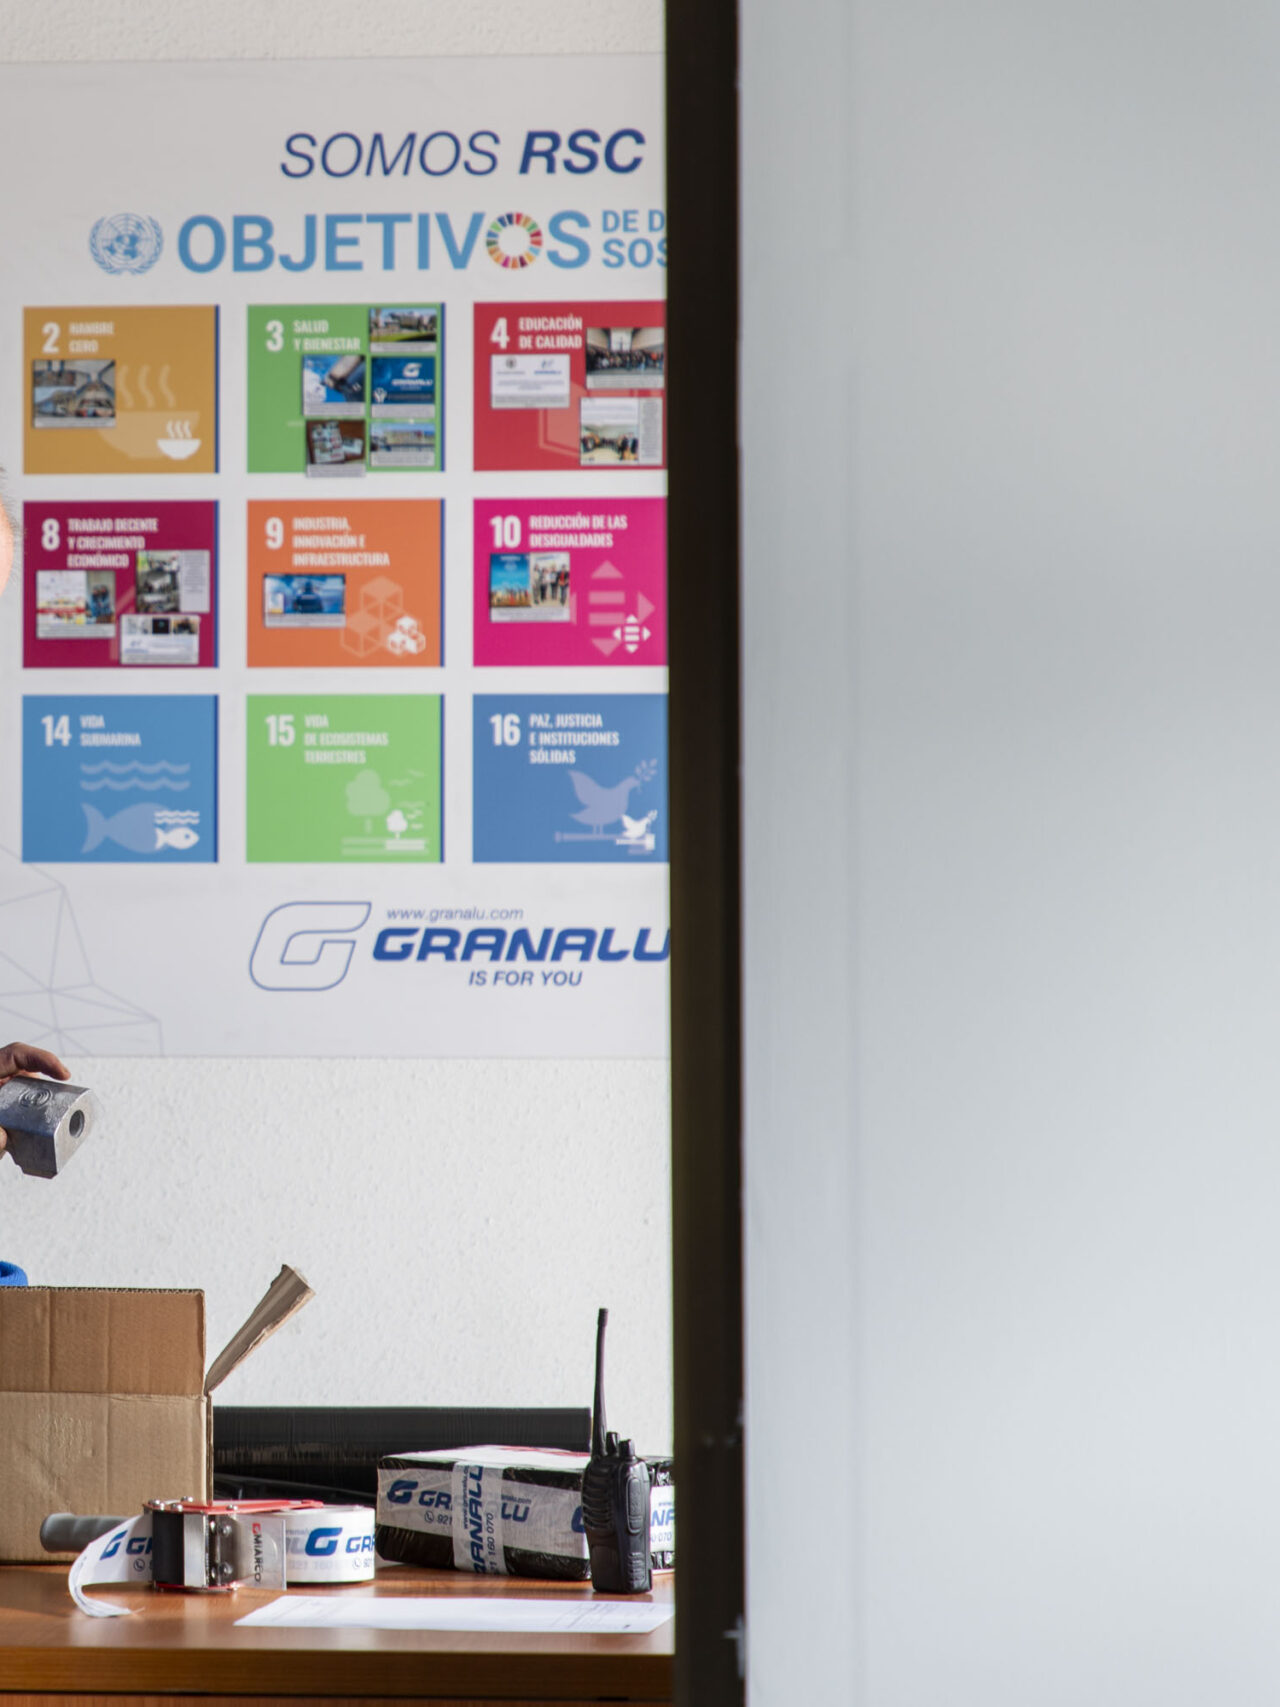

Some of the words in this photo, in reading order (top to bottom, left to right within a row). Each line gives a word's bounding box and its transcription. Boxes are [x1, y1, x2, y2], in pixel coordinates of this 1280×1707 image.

[280, 131, 501, 178] SOMOS
[518, 128, 646, 176] RSC
[601, 209, 640, 233] DE
[177, 210, 592, 273] OBJETIVOS
[293, 319, 329, 333] SALUD
[518, 314, 583, 331] EDUCACIÓN
[42, 321, 61, 354] 2
[265, 319, 284, 352] 3
[490, 317, 511, 350] 4
[518, 335, 533, 349] DE
[535, 335, 583, 349] CALIDAD
[293, 337, 301, 351] Y
[303, 337, 361, 351] BIENESTAR
[529, 512, 590, 529] REDUCCIÓN
[592, 515, 605, 529] DE
[607, 515, 628, 529] LAS
[41, 517, 61, 551] 8
[265, 516, 284, 550] 9
[490, 515, 521, 548] 10
[529, 532, 614, 548] DESIGUALDADES
[67, 535, 76, 550] Y
[358, 534, 366, 549] E
[292, 552, 391, 566] INFRAESTRUCTURA
[80, 715, 106, 728] VIDA
[304, 714, 330, 728] VIDA
[529, 713, 553, 728] PAZ,
[555, 713, 603, 728] JUSTICIA
[41, 714, 72, 747] 14
[265, 714, 295, 747] 15
[490, 713, 521, 746] 16
[304, 732, 318, 746] DE
[319, 732, 389, 746] ECOSISTEMAS
[529, 732, 537, 746] E
[538, 732, 620, 746] INSTITUCIONES
[529, 747, 576, 764] SÓLIDAS
[386, 905, 524, 923] www.granalu.com
[372, 927, 670, 962] GRANALU
[469, 970, 488, 987] IS
[493, 970, 535, 987] FOR
[541, 970, 583, 987] YOU
[485, 1512, 495, 1534] 070
[253, 1533, 264, 1583] MIARCO
